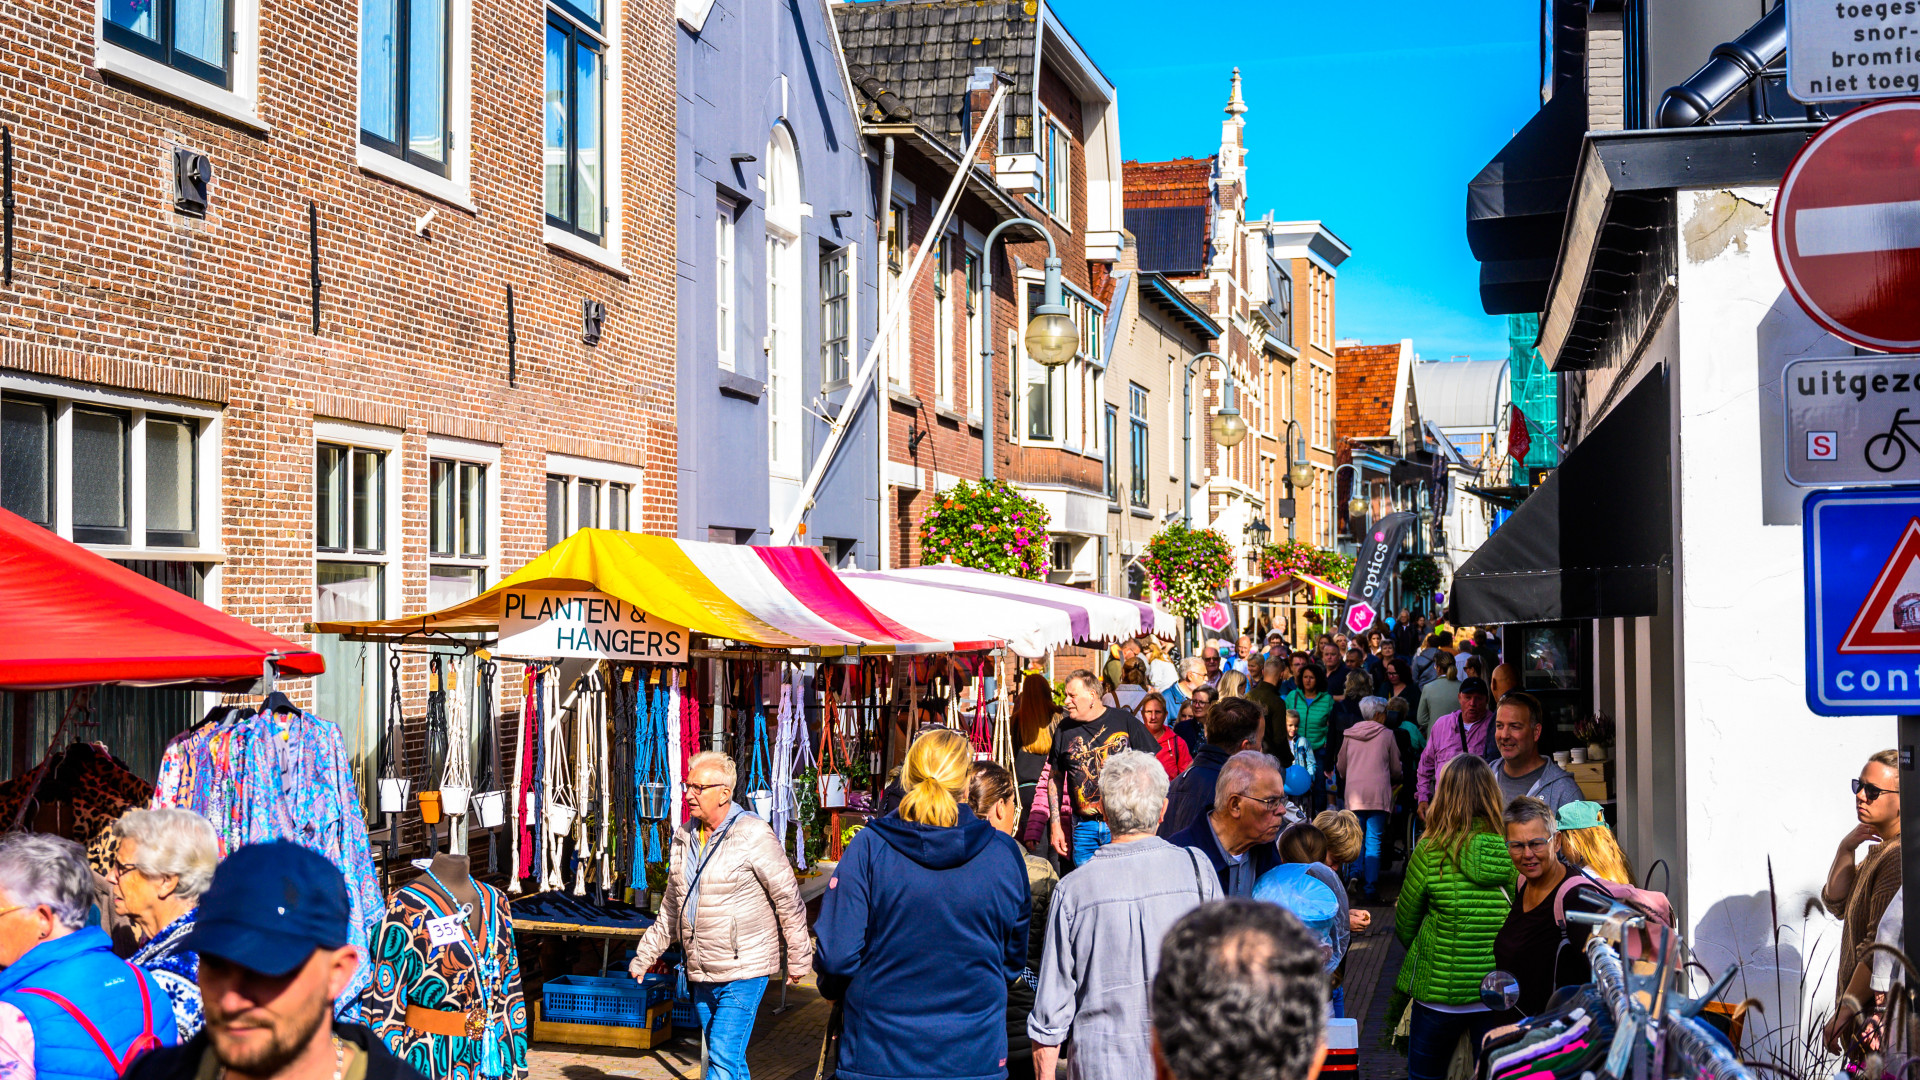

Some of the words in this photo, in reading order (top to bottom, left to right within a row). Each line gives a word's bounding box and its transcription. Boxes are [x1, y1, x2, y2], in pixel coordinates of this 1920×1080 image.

[1836, 1, 1920, 21] toeges
[1854, 26, 1918, 42] snor-
[1810, 75, 1857, 93] niet
[1813, 436, 1831, 456] S
[1363, 543, 1388, 597] optics
[505, 593, 621, 623] PLANTEN
[630, 605, 647, 623] &
[557, 626, 681, 656] HANGERS
